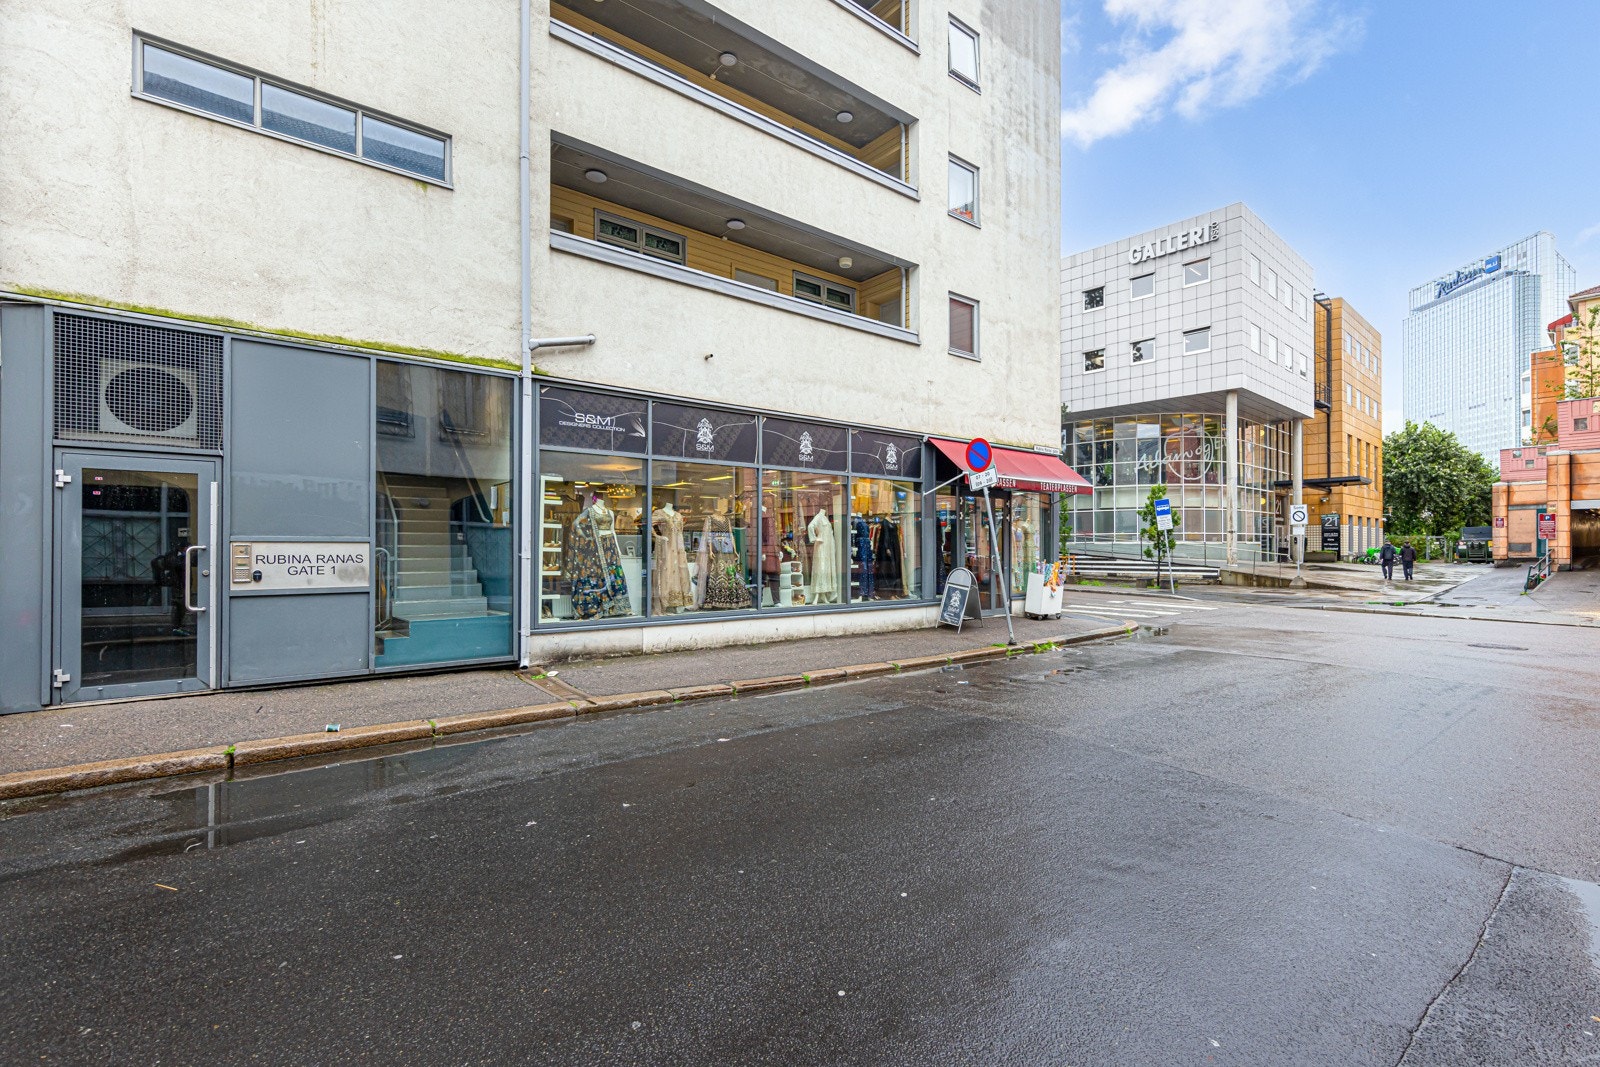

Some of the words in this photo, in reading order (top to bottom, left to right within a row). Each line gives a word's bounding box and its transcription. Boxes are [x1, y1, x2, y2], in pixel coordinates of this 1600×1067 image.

[1128, 224, 1211, 264] GALLERI
[575, 412, 611, 426] S&M
[558, 420, 591, 429] DESIGNERS
[592, 424, 626, 432] COLLECTION
[695, 443, 715, 452] S&M
[798, 454, 814, 463] S&M
[1040, 482, 1078, 493] TEATERPLASSEN
[1324, 517, 1338, 527] 21
[255, 554, 312, 565] RUBINA
[316, 553, 364, 564] RANAS
[287, 565, 325, 576] GATE
[330, 565, 337, 575] 1
